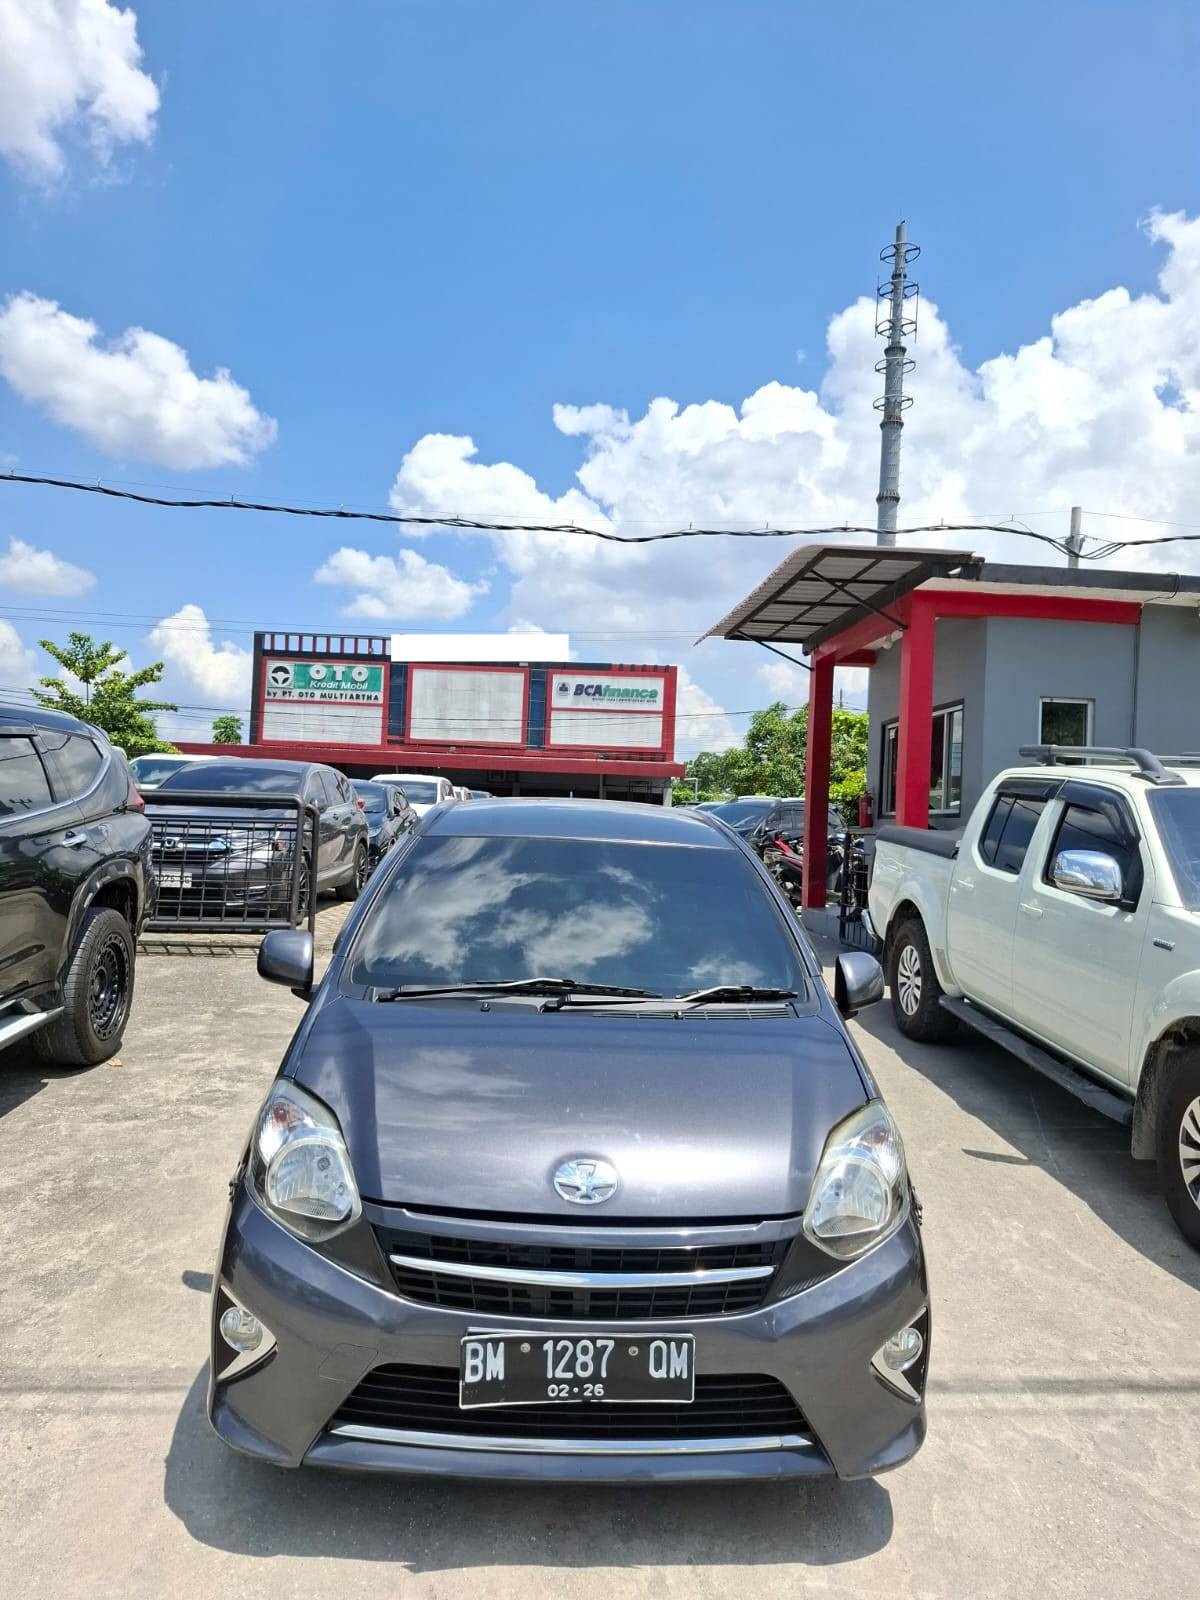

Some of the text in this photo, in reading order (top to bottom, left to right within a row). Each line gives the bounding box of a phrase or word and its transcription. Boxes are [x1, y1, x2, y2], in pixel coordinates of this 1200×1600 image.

[309, 664, 369, 682] OTO
[309, 681, 368, 690] Kredit Mobil
[266, 689, 278, 698] by
[319, 692, 379, 701] MULTIARTHA
[464, 1340, 688, 1383] BM 1287 QM
